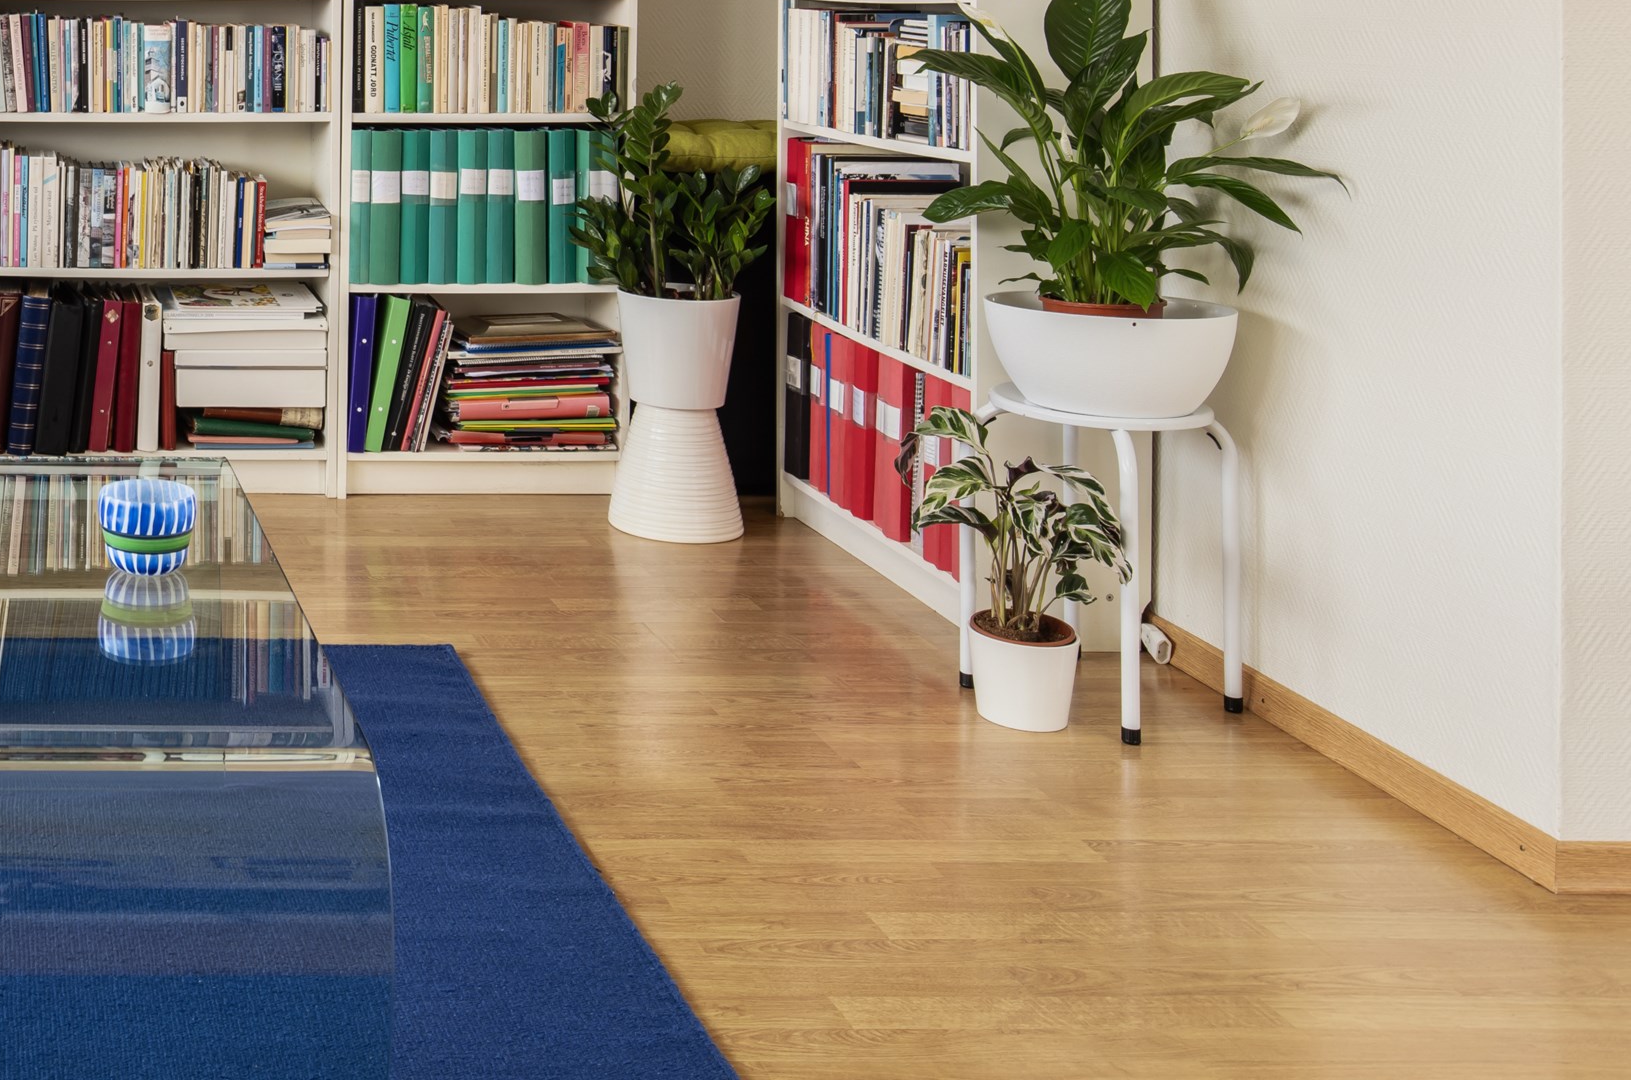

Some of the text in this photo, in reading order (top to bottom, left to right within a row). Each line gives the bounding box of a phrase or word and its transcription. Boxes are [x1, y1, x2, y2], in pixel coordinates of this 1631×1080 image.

[385, 22, 398, 61] Pubertet
[402, 22, 415, 50] Asfalt
[273, 51, 281, 91] JOHAN III
